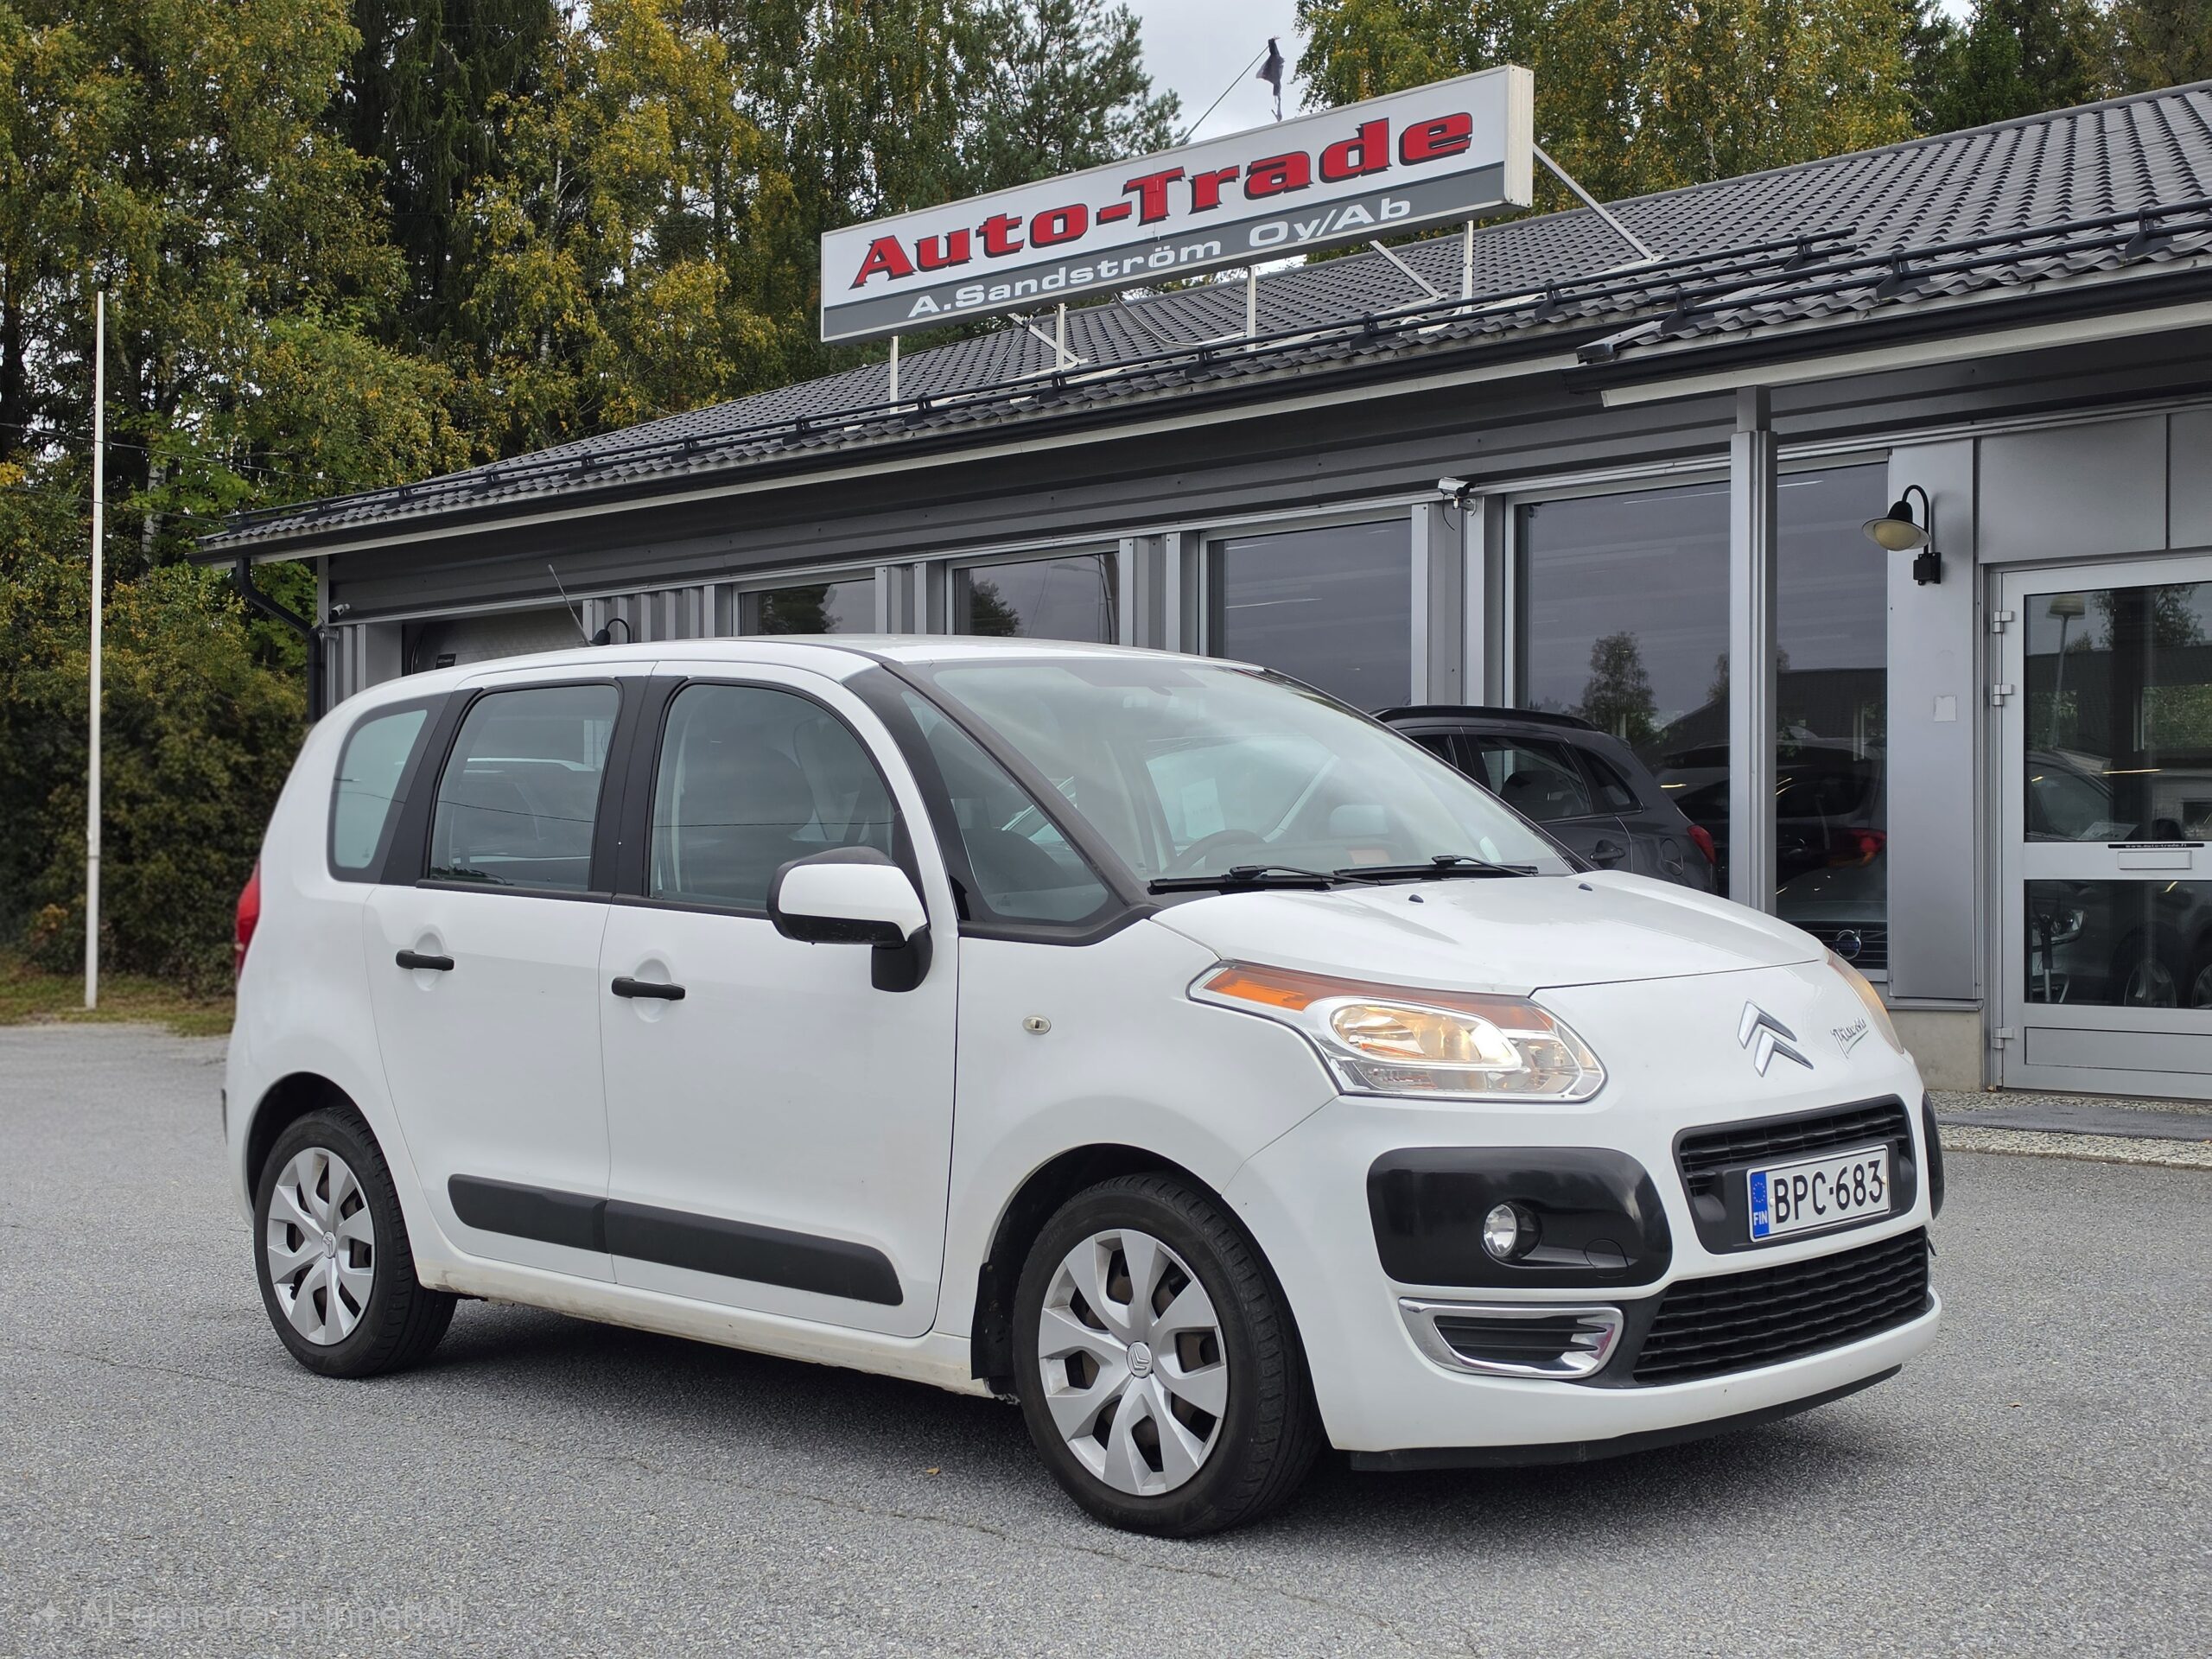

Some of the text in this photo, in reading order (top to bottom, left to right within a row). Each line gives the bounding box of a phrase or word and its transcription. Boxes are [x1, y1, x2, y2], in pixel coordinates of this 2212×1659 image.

[849, 112, 1473, 289] Auto-Trade
[908, 198, 1410, 317] A.Sandström Oy/Ab
[1752, 1210, 1769, 1226] FIN
[1773, 1159, 1884, 1224] BPC-683
